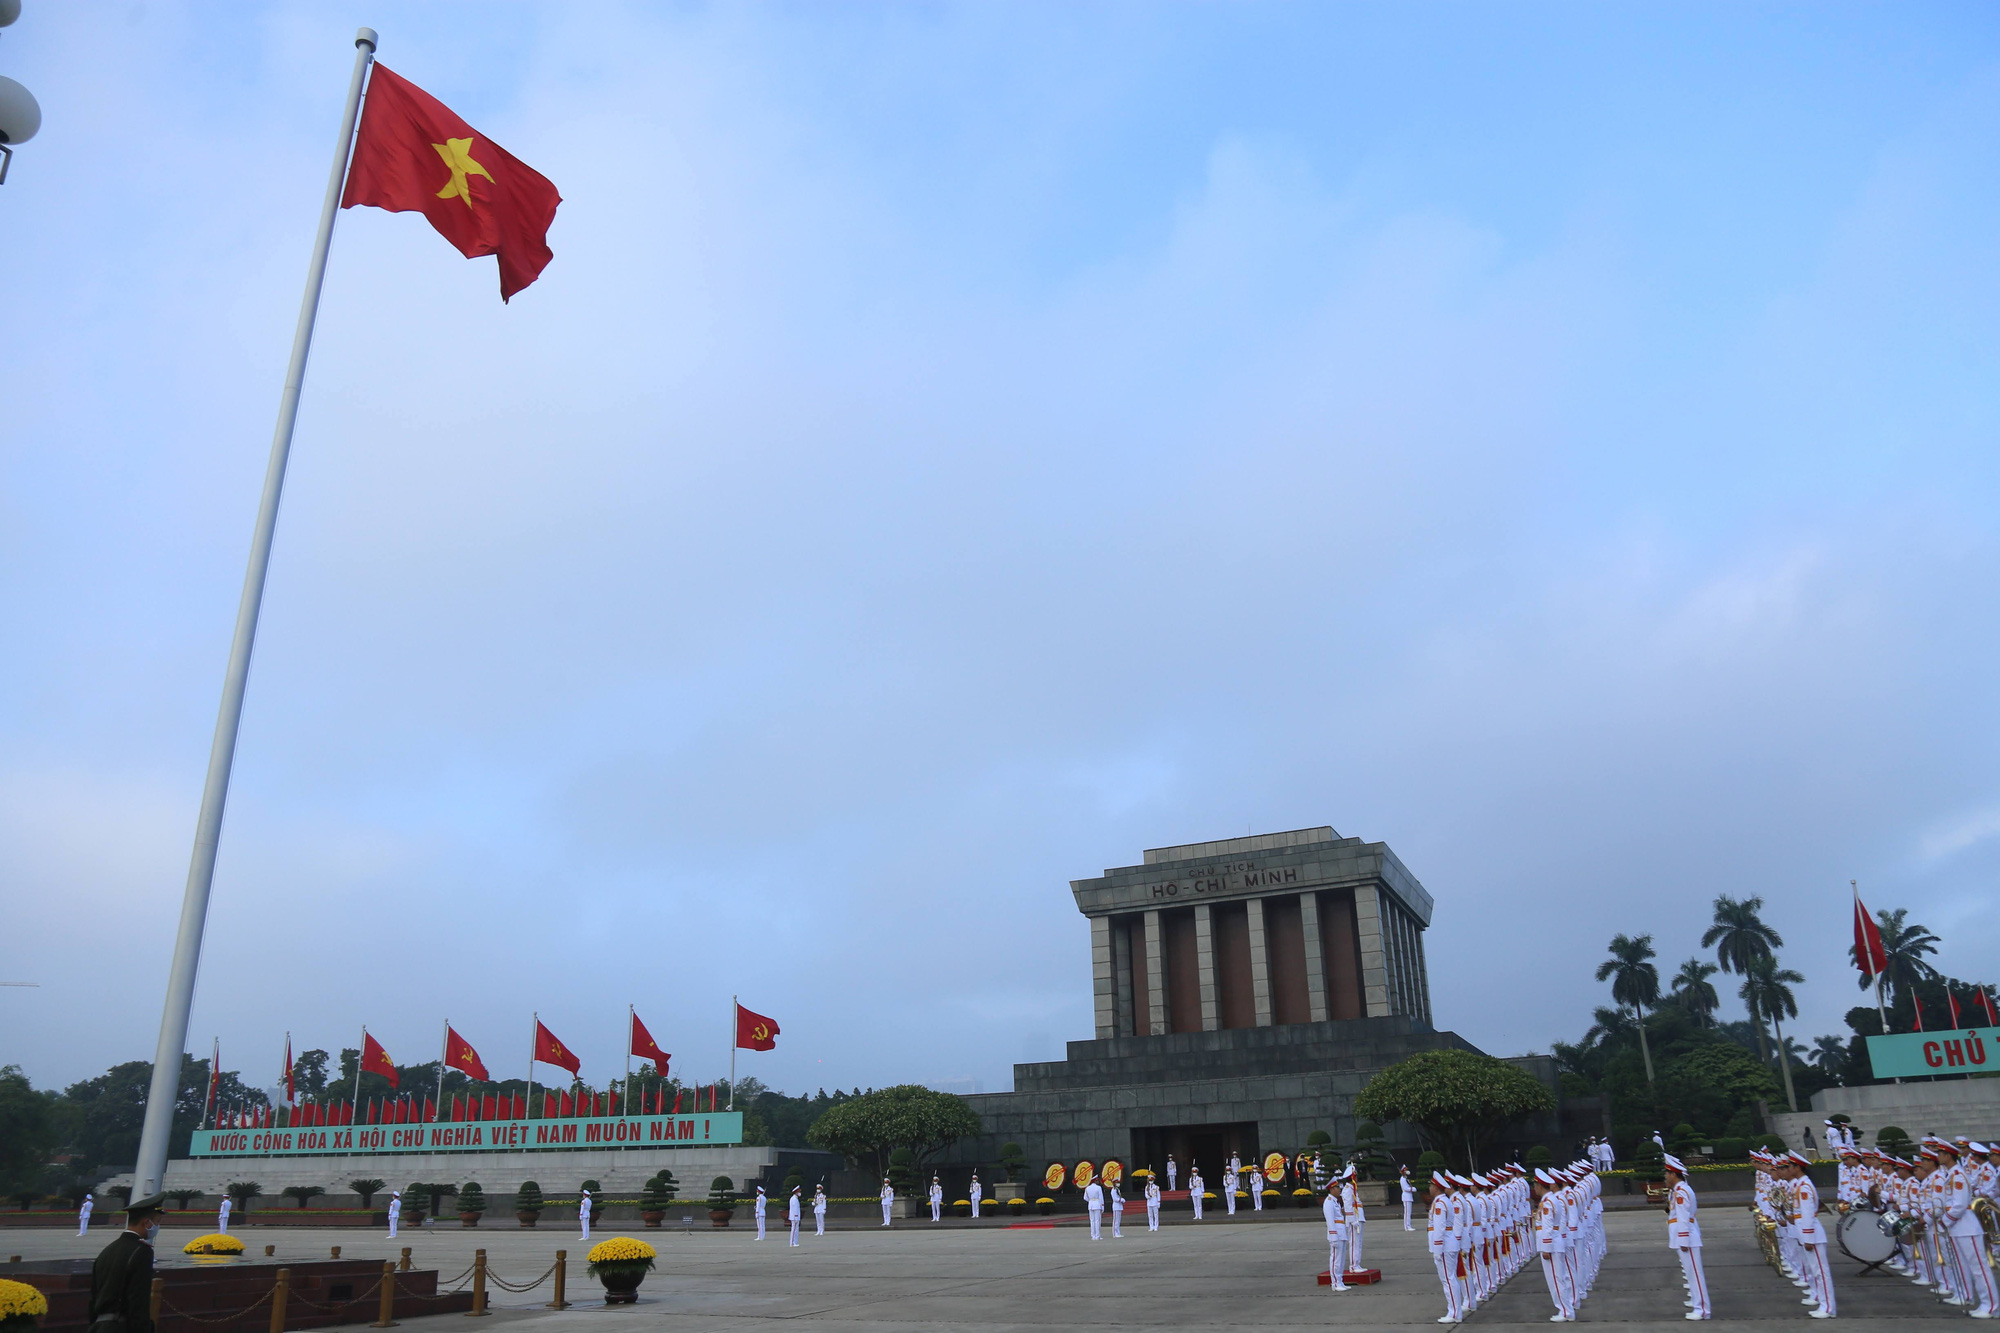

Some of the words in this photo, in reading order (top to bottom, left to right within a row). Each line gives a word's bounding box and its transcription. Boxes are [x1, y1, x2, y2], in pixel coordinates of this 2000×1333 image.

[1244, 868, 1297, 887] MINH
[1923, 1030, 1986, 1068] CHỦ
[210, 1131, 248, 1151] NƯỚC
[253, 1130, 292, 1153] CỘNG
[297, 1129, 327, 1149] HÒA
[333, 1128, 353, 1149] XÃ
[359, 1127, 386, 1151] HỘI
[392, 1124, 425, 1147] CHỦ
[431, 1124, 482, 1146] NGHĨA
[492, 1124, 529, 1148] VIỆT
[537, 1124, 577, 1144] NAM
[585, 1119, 642, 1143] MUÔN
[650, 1117, 695, 1141] NĂM
